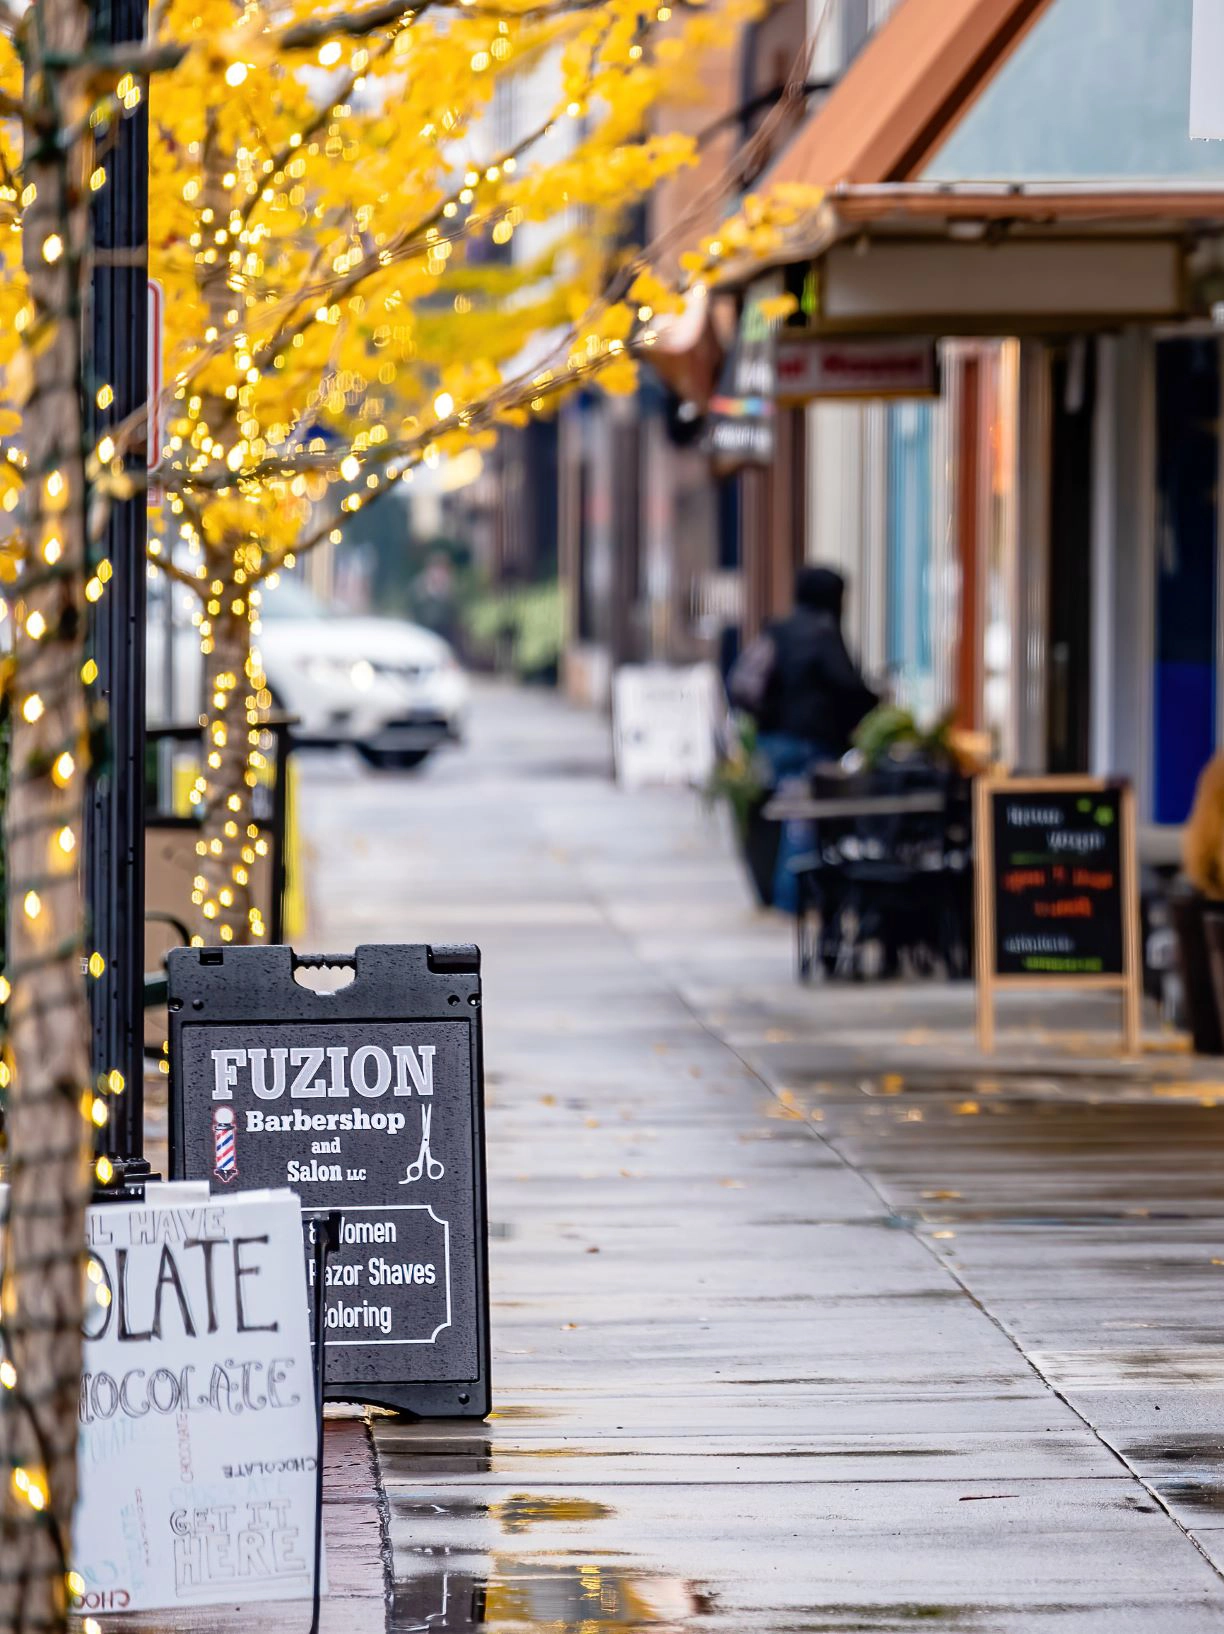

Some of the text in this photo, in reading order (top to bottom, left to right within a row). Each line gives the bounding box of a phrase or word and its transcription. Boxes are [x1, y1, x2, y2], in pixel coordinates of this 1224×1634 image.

[211, 1045, 436, 1100] FUZION
[245, 1108, 406, 1134] Barbershop
[311, 1136, 341, 1154] and
[287, 1159, 367, 1183] Salon LLC
[129, 1207, 227, 1246] HAVE
[339, 1216, 397, 1244] omen
[368, 1257, 436, 1285] Shaves
[324, 1299, 392, 1334] oloring
[222, 1456, 318, 1479] CHOCOLATE
[169, 1504, 236, 1537] GET
[246, 1498, 292, 1531] IT
[174, 1526, 307, 1587] HERE
